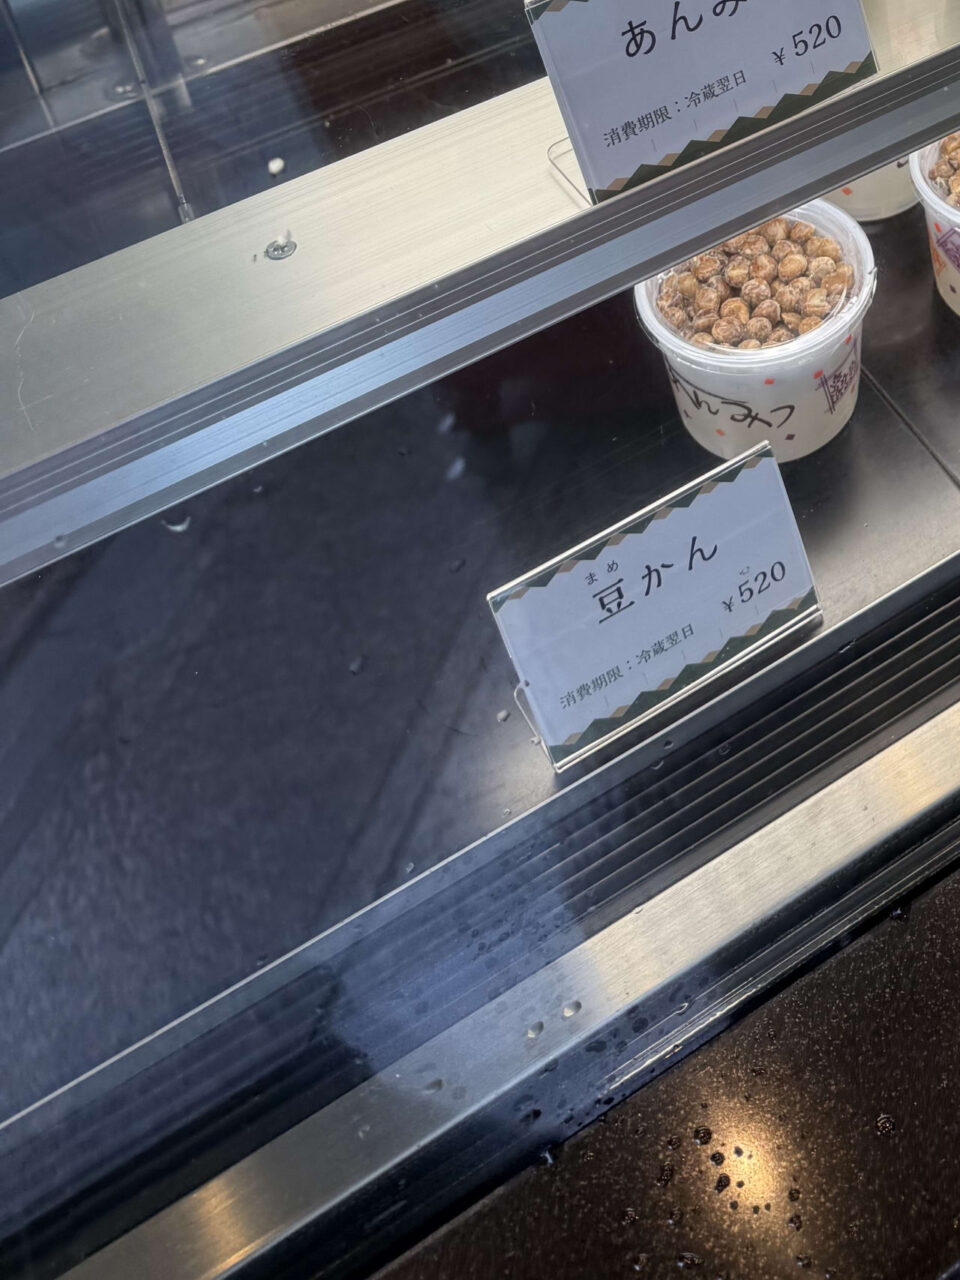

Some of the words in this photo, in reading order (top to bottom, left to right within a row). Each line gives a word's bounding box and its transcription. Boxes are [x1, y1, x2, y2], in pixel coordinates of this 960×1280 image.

[771, 14, 843, 66] ¥520
[603, 70, 747, 148] 消費期限：冷蔵翌日
[585, 559, 620, 586] まめ
[592, 535, 718, 624] 豆かん
[722, 560, 786, 613] ¥520
[559, 624, 696, 710] 消費期限：冷蔵翌日
